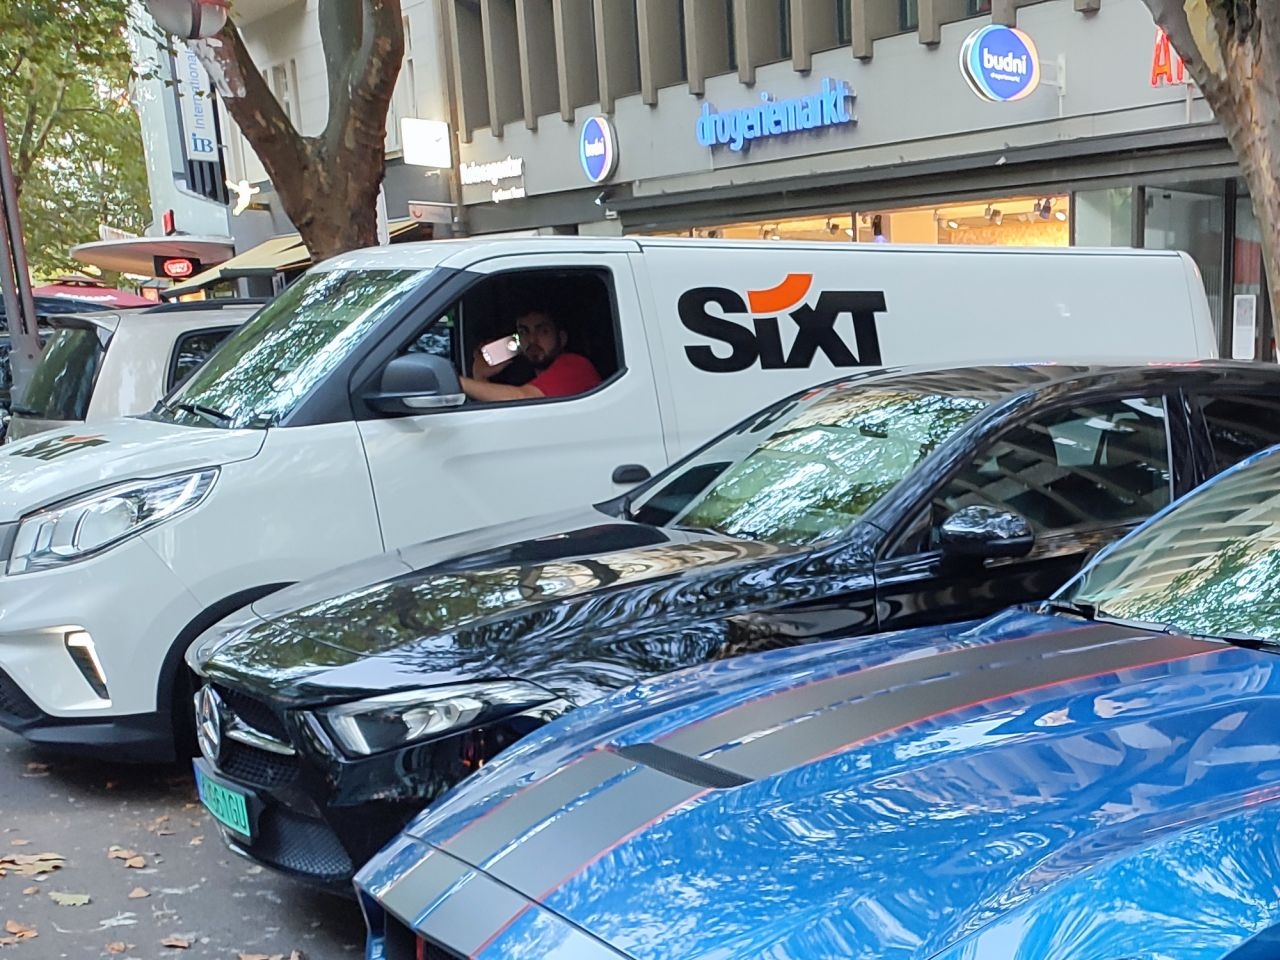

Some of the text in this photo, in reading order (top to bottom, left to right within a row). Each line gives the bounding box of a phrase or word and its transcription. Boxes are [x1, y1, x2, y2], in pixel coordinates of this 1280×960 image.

[983, 48, 1026, 75] budni
[696, 77, 851, 151] drogeriemarkt
[678, 274, 888, 373] SIXT
